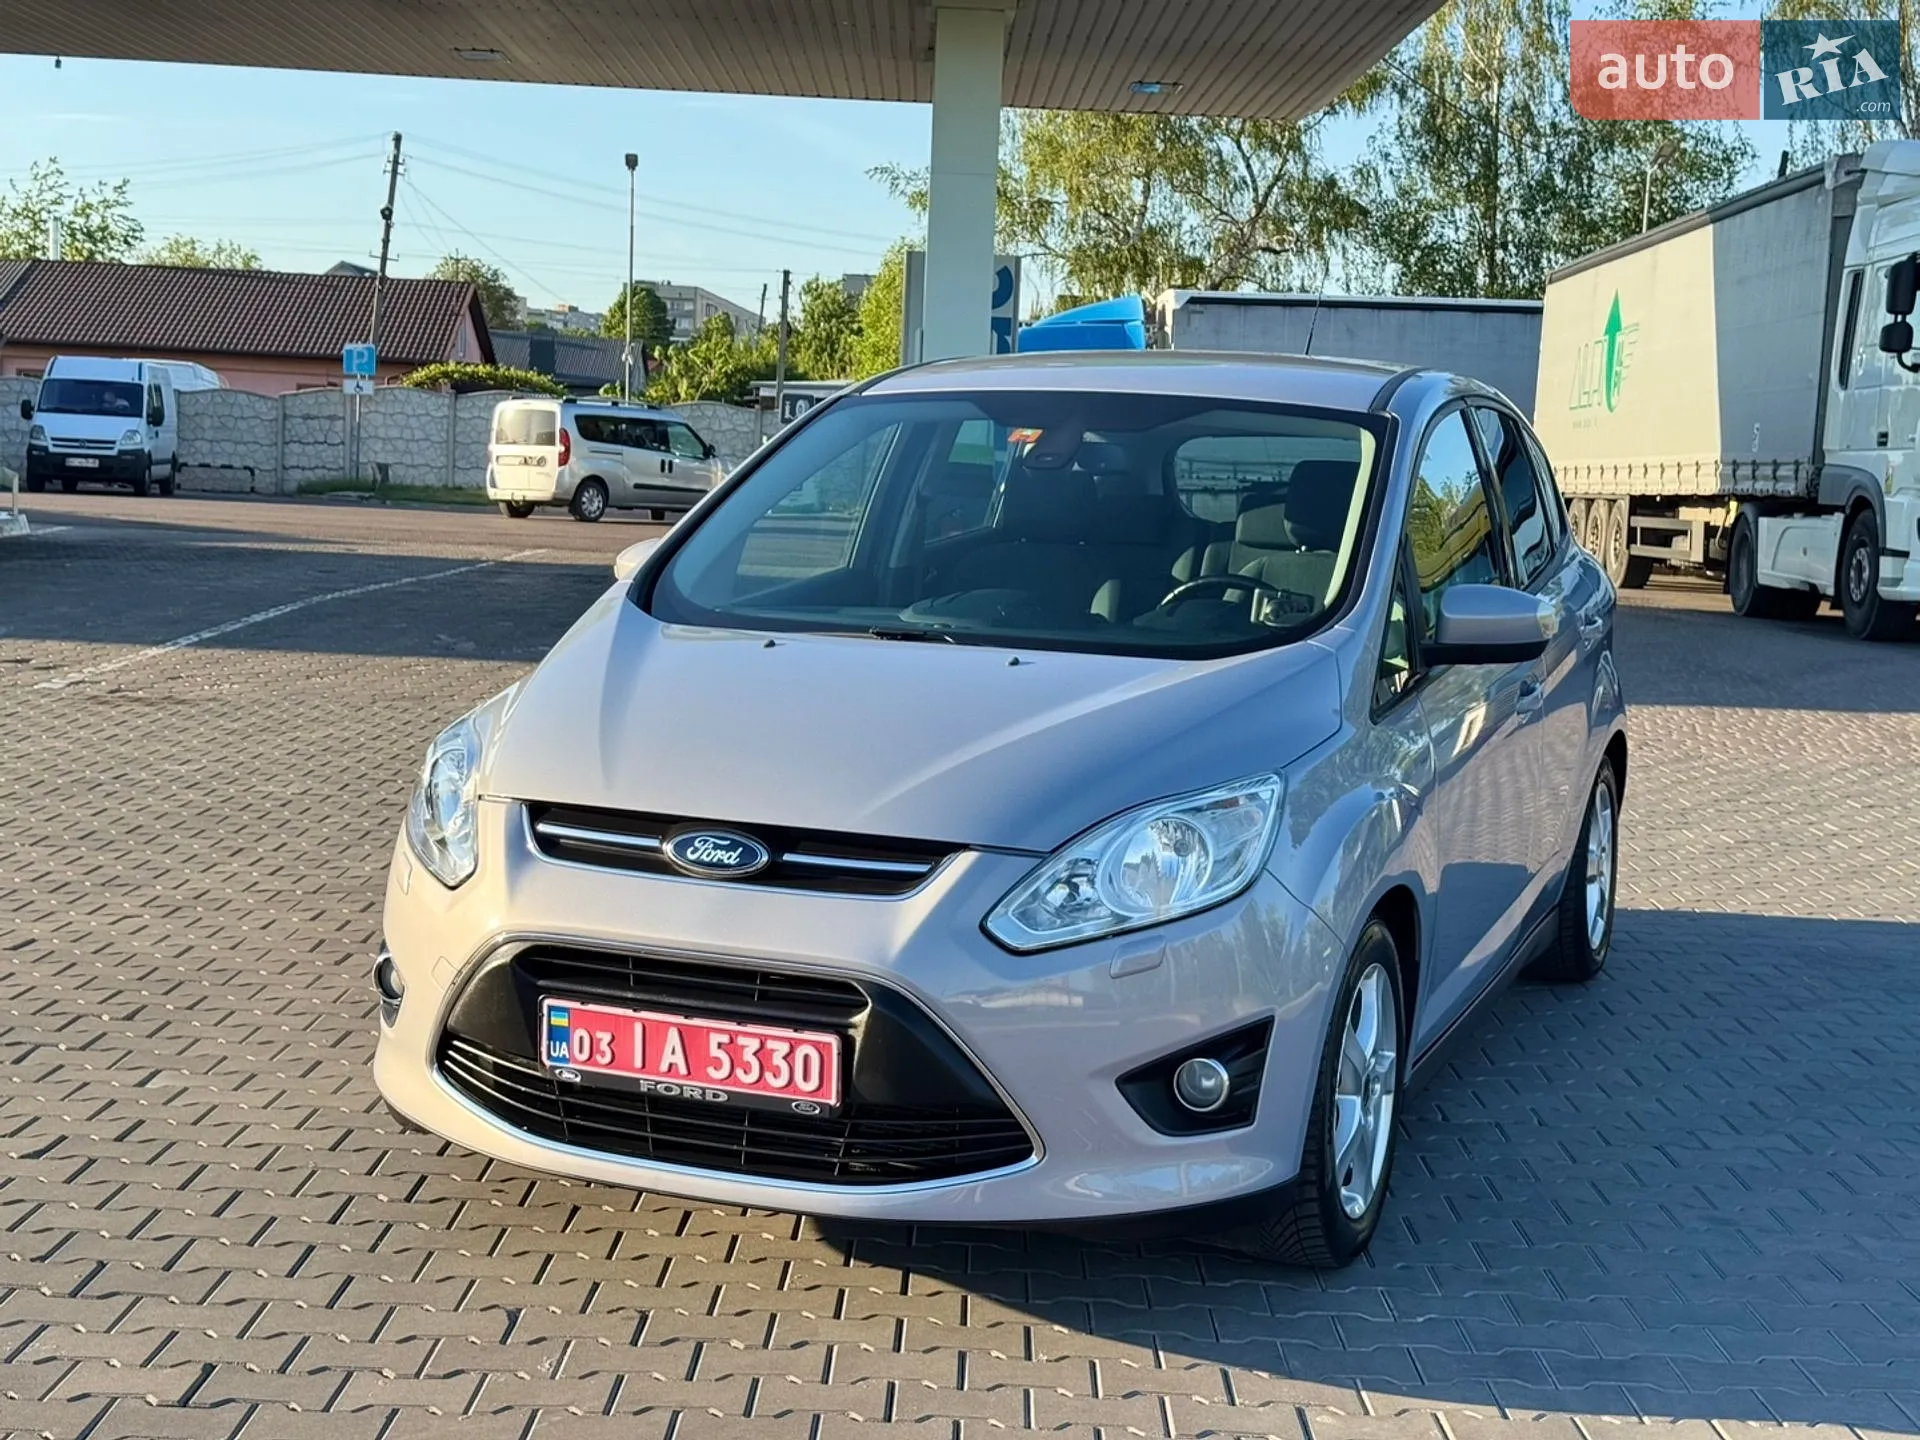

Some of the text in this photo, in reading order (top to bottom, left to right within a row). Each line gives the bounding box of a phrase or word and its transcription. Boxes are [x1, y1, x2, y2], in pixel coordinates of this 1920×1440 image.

[353, 349, 369, 372] P
[686, 836, 743, 865] Ford
[550, 1040, 570, 1058] UA
[706, 1031, 822, 1093] 5330
[639, 1079, 729, 1102] FORD
